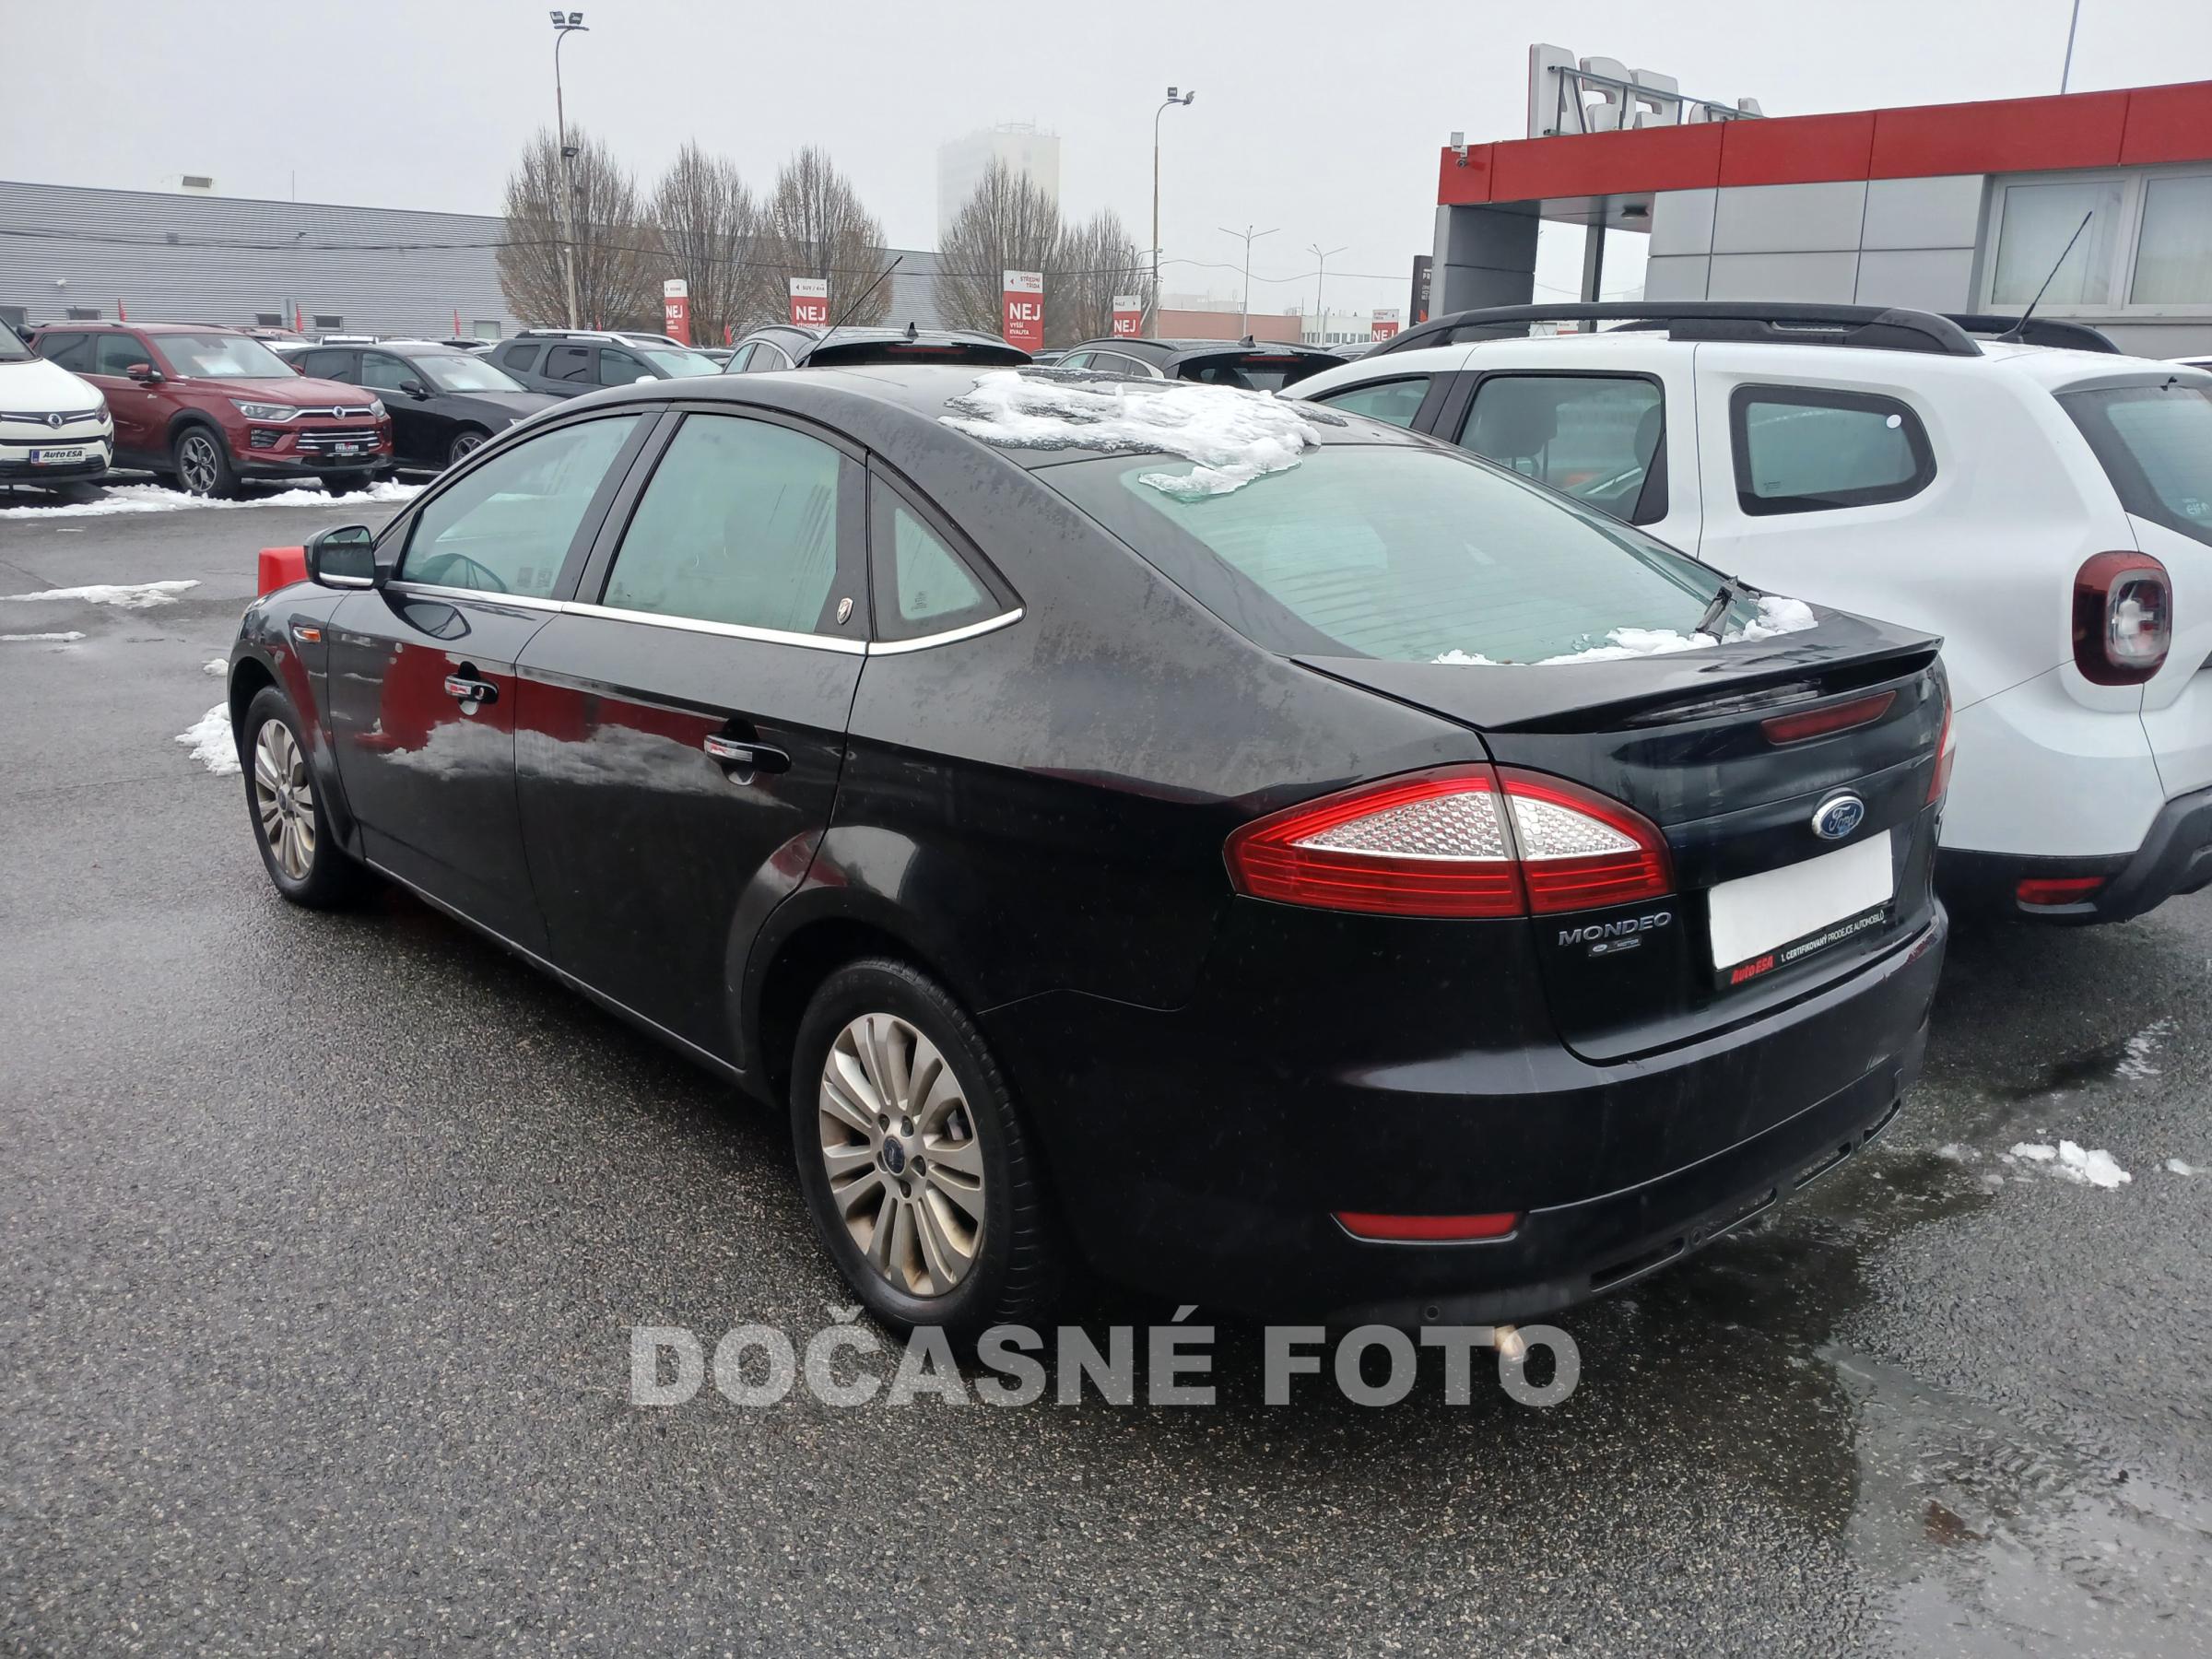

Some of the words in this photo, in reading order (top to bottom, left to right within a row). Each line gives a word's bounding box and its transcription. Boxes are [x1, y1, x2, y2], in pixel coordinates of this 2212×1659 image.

[665, 304, 684, 319] NEJ
[795, 305, 826, 321] NEJ
[1009, 302, 1041, 321] NEJ
[1113, 319, 1136, 333] NEJ
[1830, 805, 1857, 832] Ford
[1558, 912, 1672, 946] MONDEO
[1785, 933, 1828, 960] CERTIFIKOVANÝ
[1828, 924, 1854, 943] PRODEJCE
